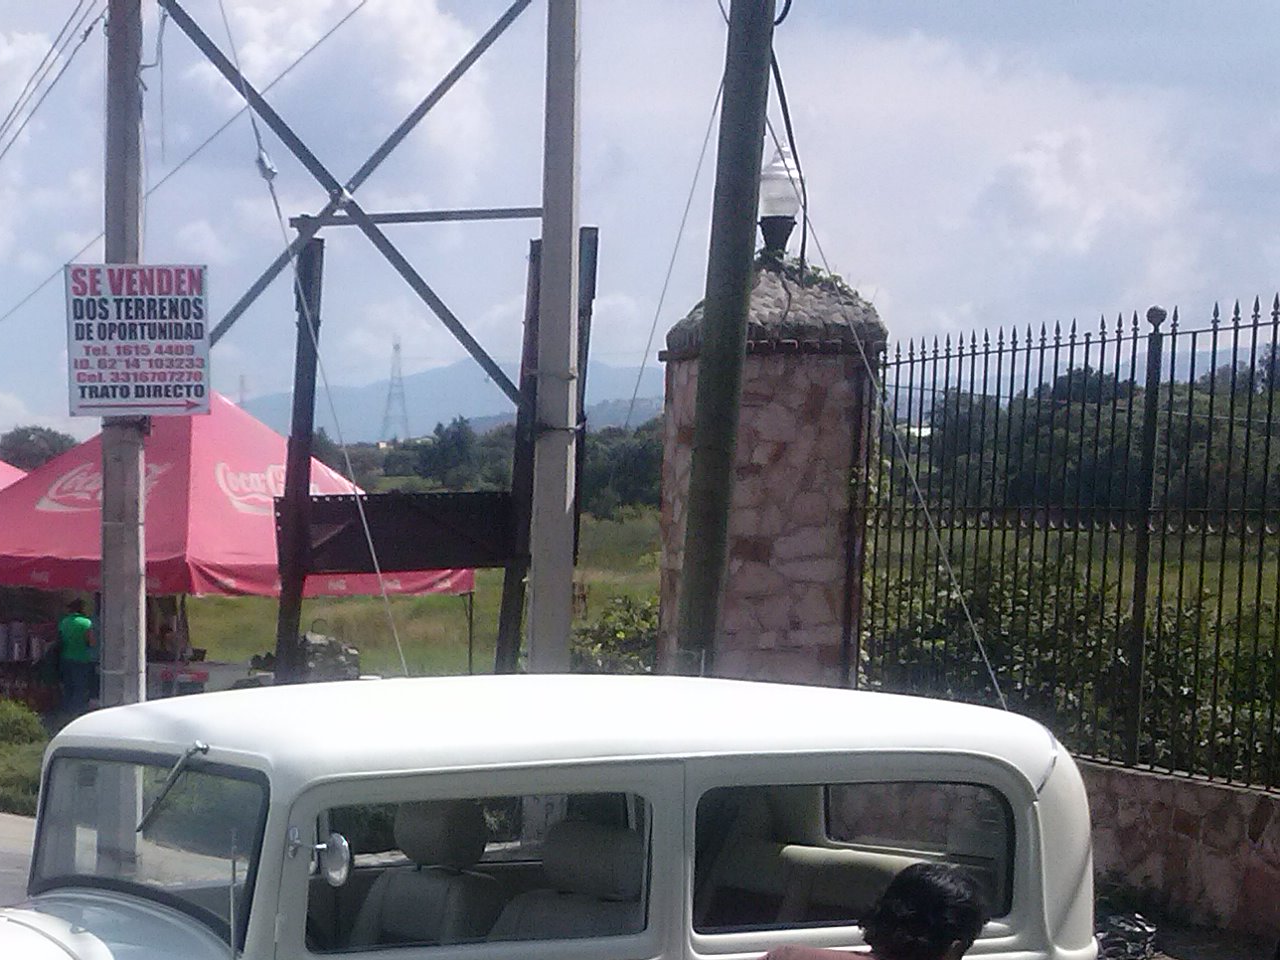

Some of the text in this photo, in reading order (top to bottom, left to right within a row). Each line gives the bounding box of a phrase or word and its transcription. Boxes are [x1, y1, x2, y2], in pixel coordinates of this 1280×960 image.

[71, 267, 204, 297] SE VENDEN
[73, 297, 204, 321] DOS TERRENOS
[75, 321, 204, 341] DE OPORTUNIDAD
[83, 345, 111, 357] Tel.
[78, 384, 205, 399] TRATO DIRECTO
